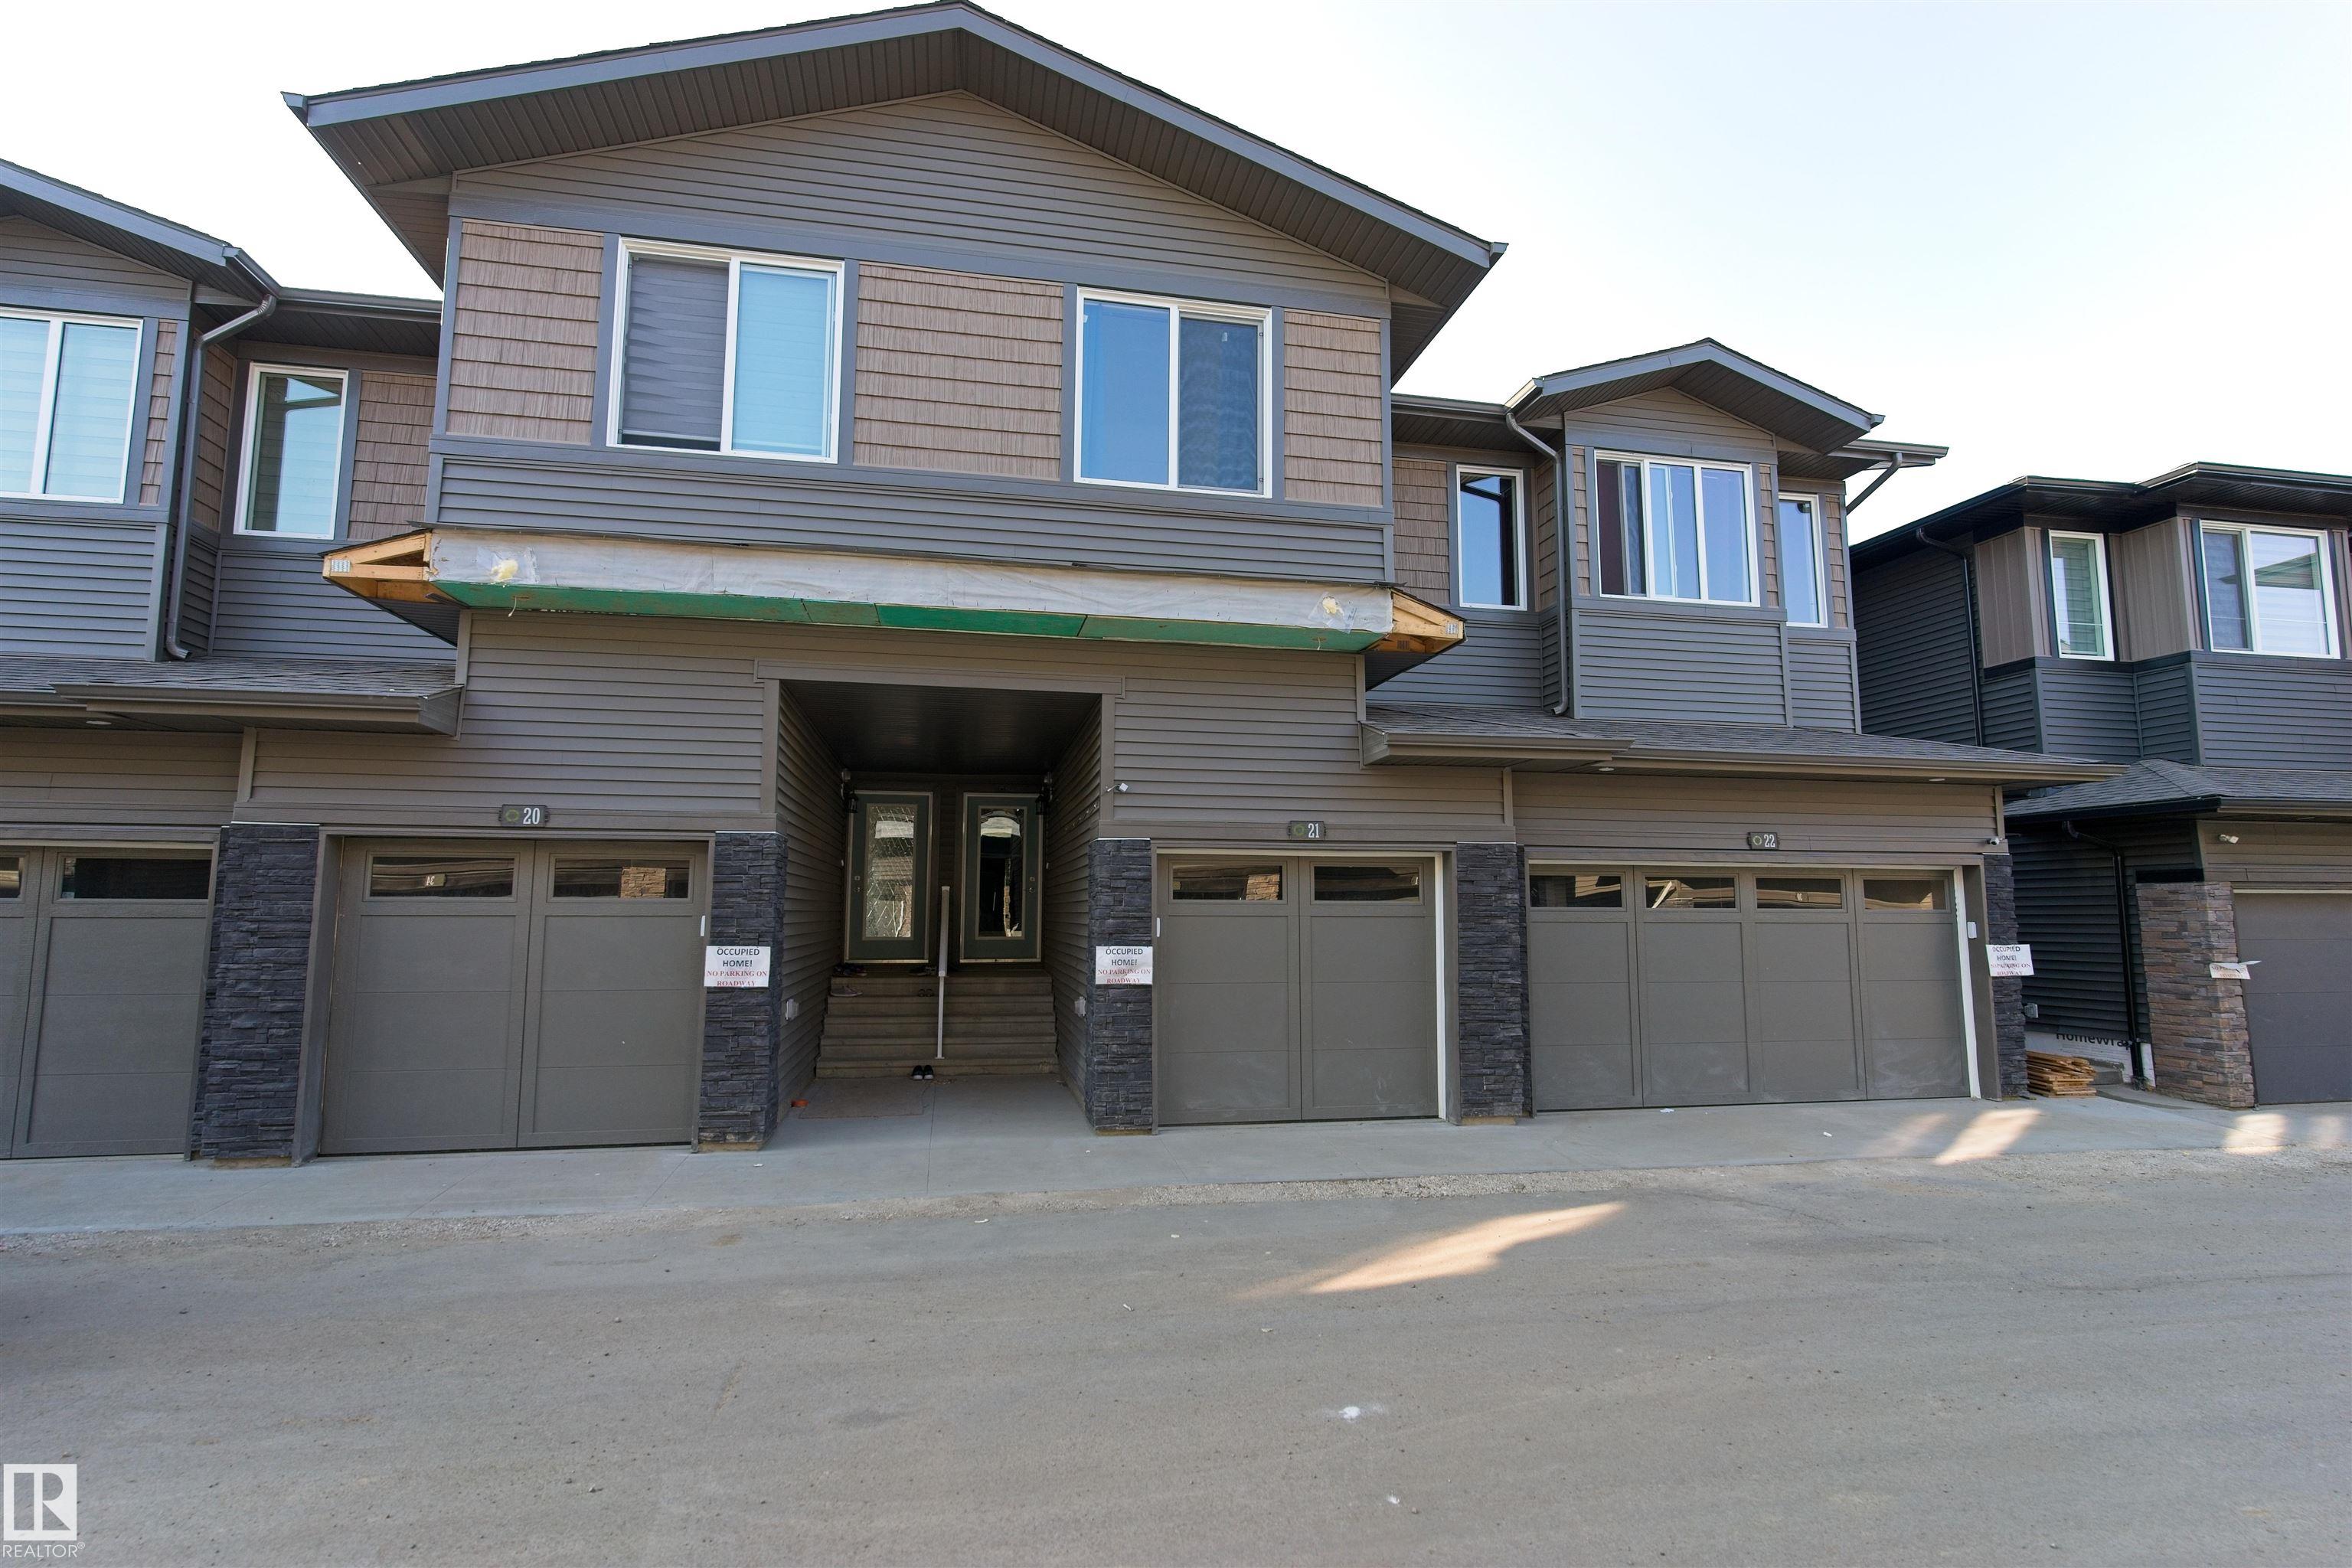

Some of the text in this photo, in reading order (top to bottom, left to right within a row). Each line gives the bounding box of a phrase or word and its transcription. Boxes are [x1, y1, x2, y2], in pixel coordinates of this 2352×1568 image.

[523, 808, 540, 825] 20
[1308, 823, 1319, 838] 21
[1763, 835, 1775, 848] 22
